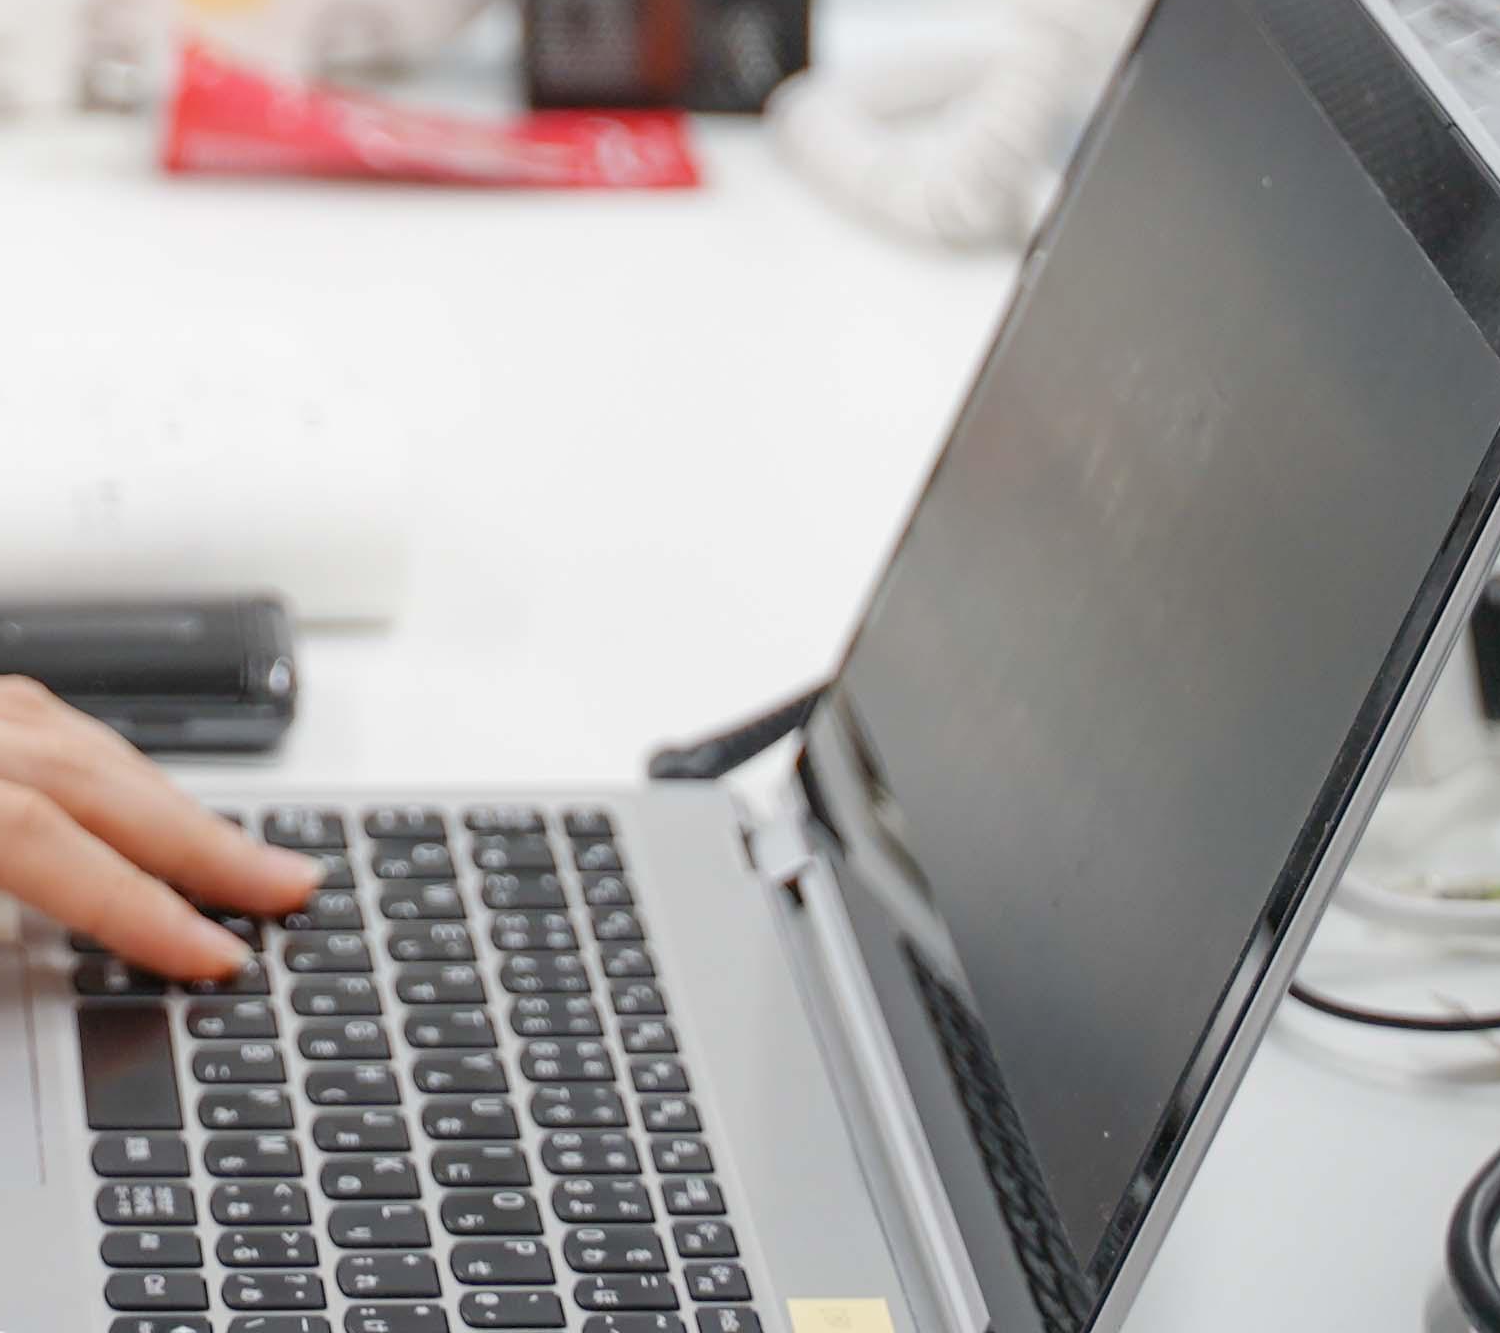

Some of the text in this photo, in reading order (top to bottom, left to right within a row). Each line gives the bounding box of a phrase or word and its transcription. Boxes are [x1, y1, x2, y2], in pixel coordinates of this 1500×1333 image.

[470, 1098, 505, 1116] U
[363, 1112, 397, 1127] J
[482, 1147, 514, 1157] I
[373, 1157, 407, 1174] K
[273, 1183, 294, 1197] <
[492, 1192, 527, 1210] O
[380, 1205, 414, 1221] L
[281, 1232, 300, 1245] >
[504, 1241, 538, 1256] P
